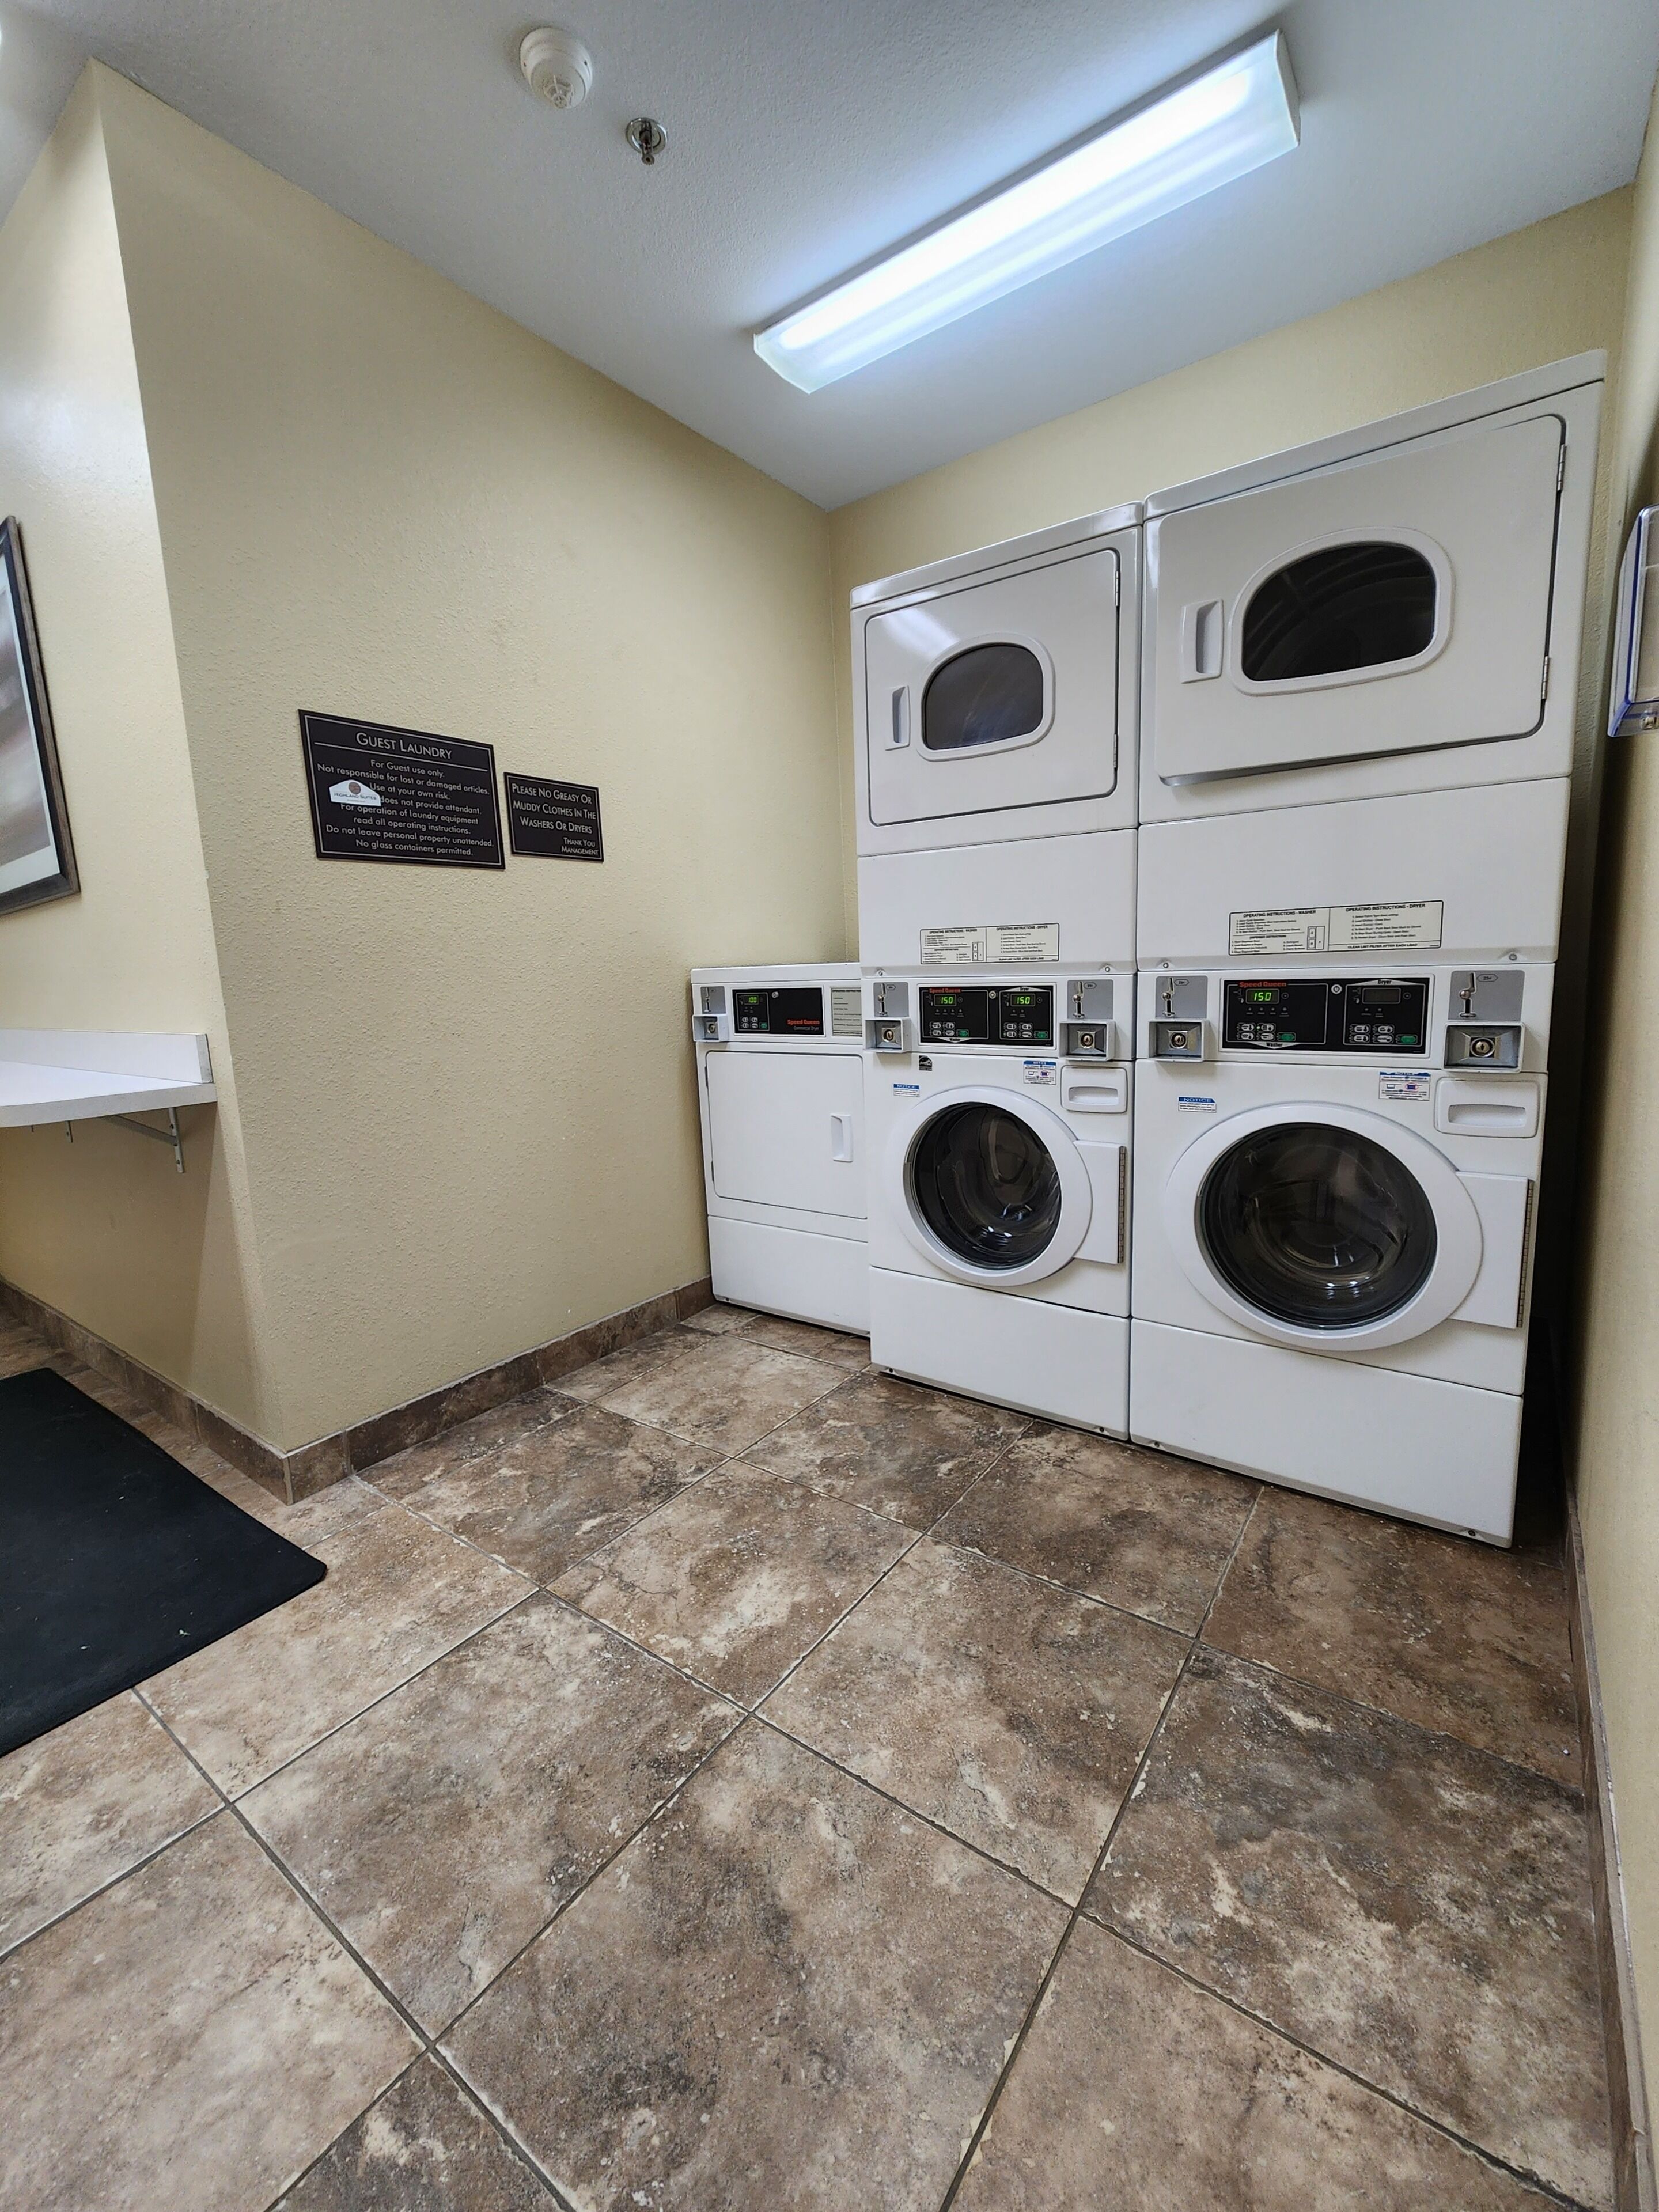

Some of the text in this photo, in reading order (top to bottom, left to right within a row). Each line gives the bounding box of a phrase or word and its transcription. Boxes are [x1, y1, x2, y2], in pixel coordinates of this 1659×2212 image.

[356, 732, 452, 759] GUEST LAUNDRY
[370, 759, 384, 768] For
[387, 762, 410, 772] Guest
[427, 769, 445, 779] only.
[317, 763, 334, 773] Not
[336, 768, 384, 780] responsible
[387, 773, 398, 781] for
[400, 775, 414, 783] lost
[426, 779, 461, 791] damaged
[464, 785, 490, 795] articles.
[369, 782, 385, 791] Use
[435, 791, 450, 800] risk.
[512, 783, 592, 805] PLEASE NO GREASY OR
[381, 796, 399, 805] does
[416, 801, 444, 810] provide
[445, 805, 482, 815] attendant.
[513, 800, 540, 812] MUDDY
[542, 804, 573, 817] CLOTHES
[584, 809, 596, 820] THE
[357, 806, 397, 816] operation
[399, 809, 407, 817] of
[410, 809, 438, 821] laundry
[441, 815, 478, 824] equipment
[388, 821, 426, 831] operating
[428, 823, 471, 834] instructions.
[520, 816, 592, 834] WASHERS OR DRYERS
[326, 824, 339, 833] Do
[358, 827, 381, 836] leave
[383, 831, 418, 840] personal
[419, 835, 450, 844] property
[452, 838, 494, 847] unattended.
[563, 837, 596, 847] THANK YOU
[356, 839, 474, 855] No glass containers permitted.
[562, 846, 599, 855] MANAGEMENT
[1253, 992, 1272, 1001] 150
